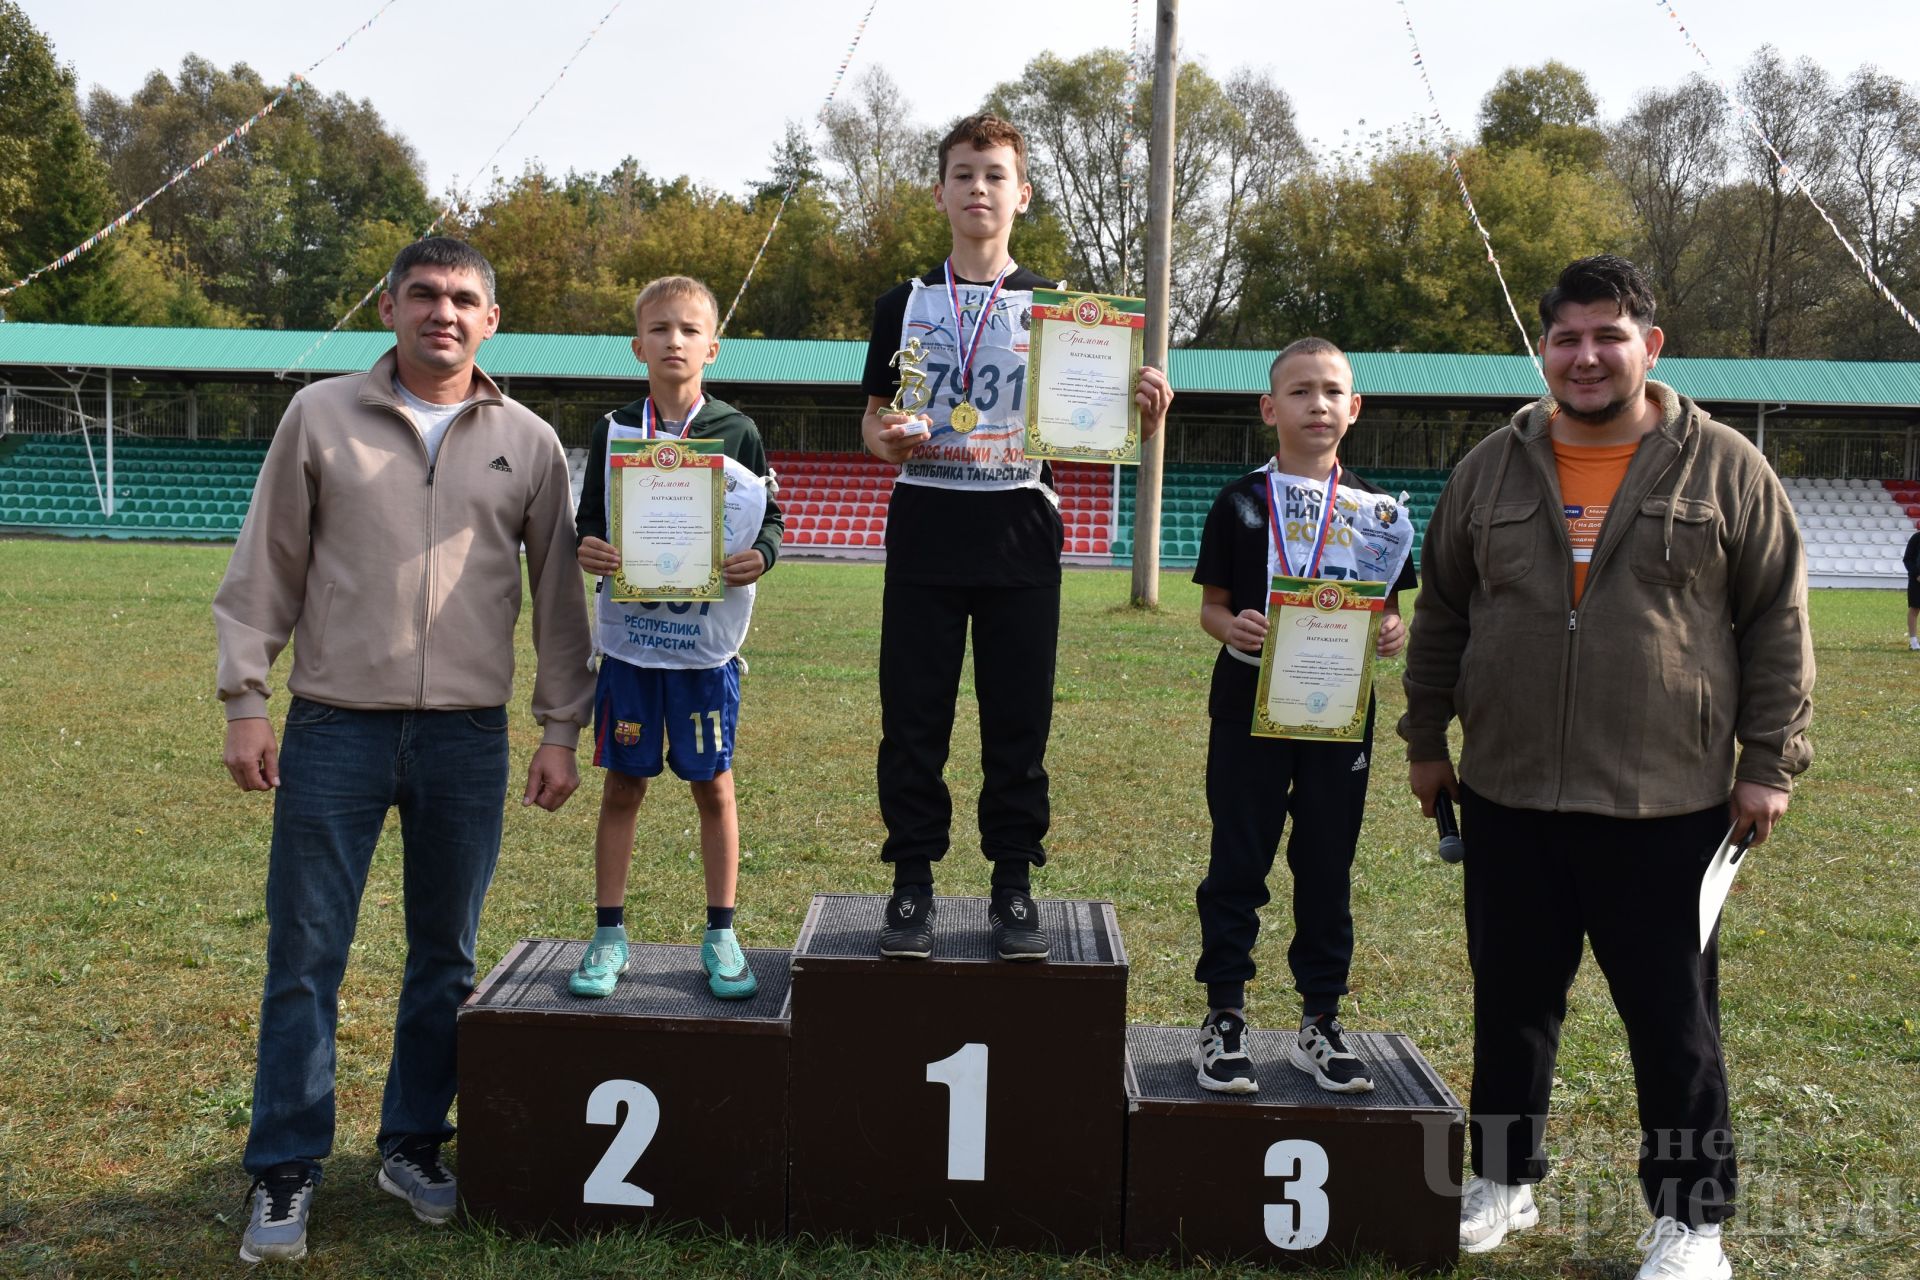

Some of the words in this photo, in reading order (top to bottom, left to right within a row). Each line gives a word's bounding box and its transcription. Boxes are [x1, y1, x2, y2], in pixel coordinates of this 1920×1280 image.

[1058, 329, 1110, 346] Грамота
[1069, 351, 1112, 360] НАГРАЖДАЕТСЯ
[926, 363, 1025, 411] 7931
[911, 445, 941, 460] РОСС
[943, 446, 992, 465] НАЦИИ
[1002, 447, 1033, 464] 201
[488, 463, 513, 473] adidas
[967, 467, 1031, 481] ТАТАРСТАН
[639, 475, 691, 491] Грамота
[1286, 521, 1353, 548] 2020
[624, 614, 701, 636] РЕСПУБЛИКА
[1295, 614, 1348, 631] Грамота
[628, 631, 696, 650] ТАТАРСТАН
[689, 710, 723, 754] 11
[926, 1043, 989, 1181] 1
[583, 1079, 661, 1207] 2
[1263, 1139, 1330, 1250] 3
